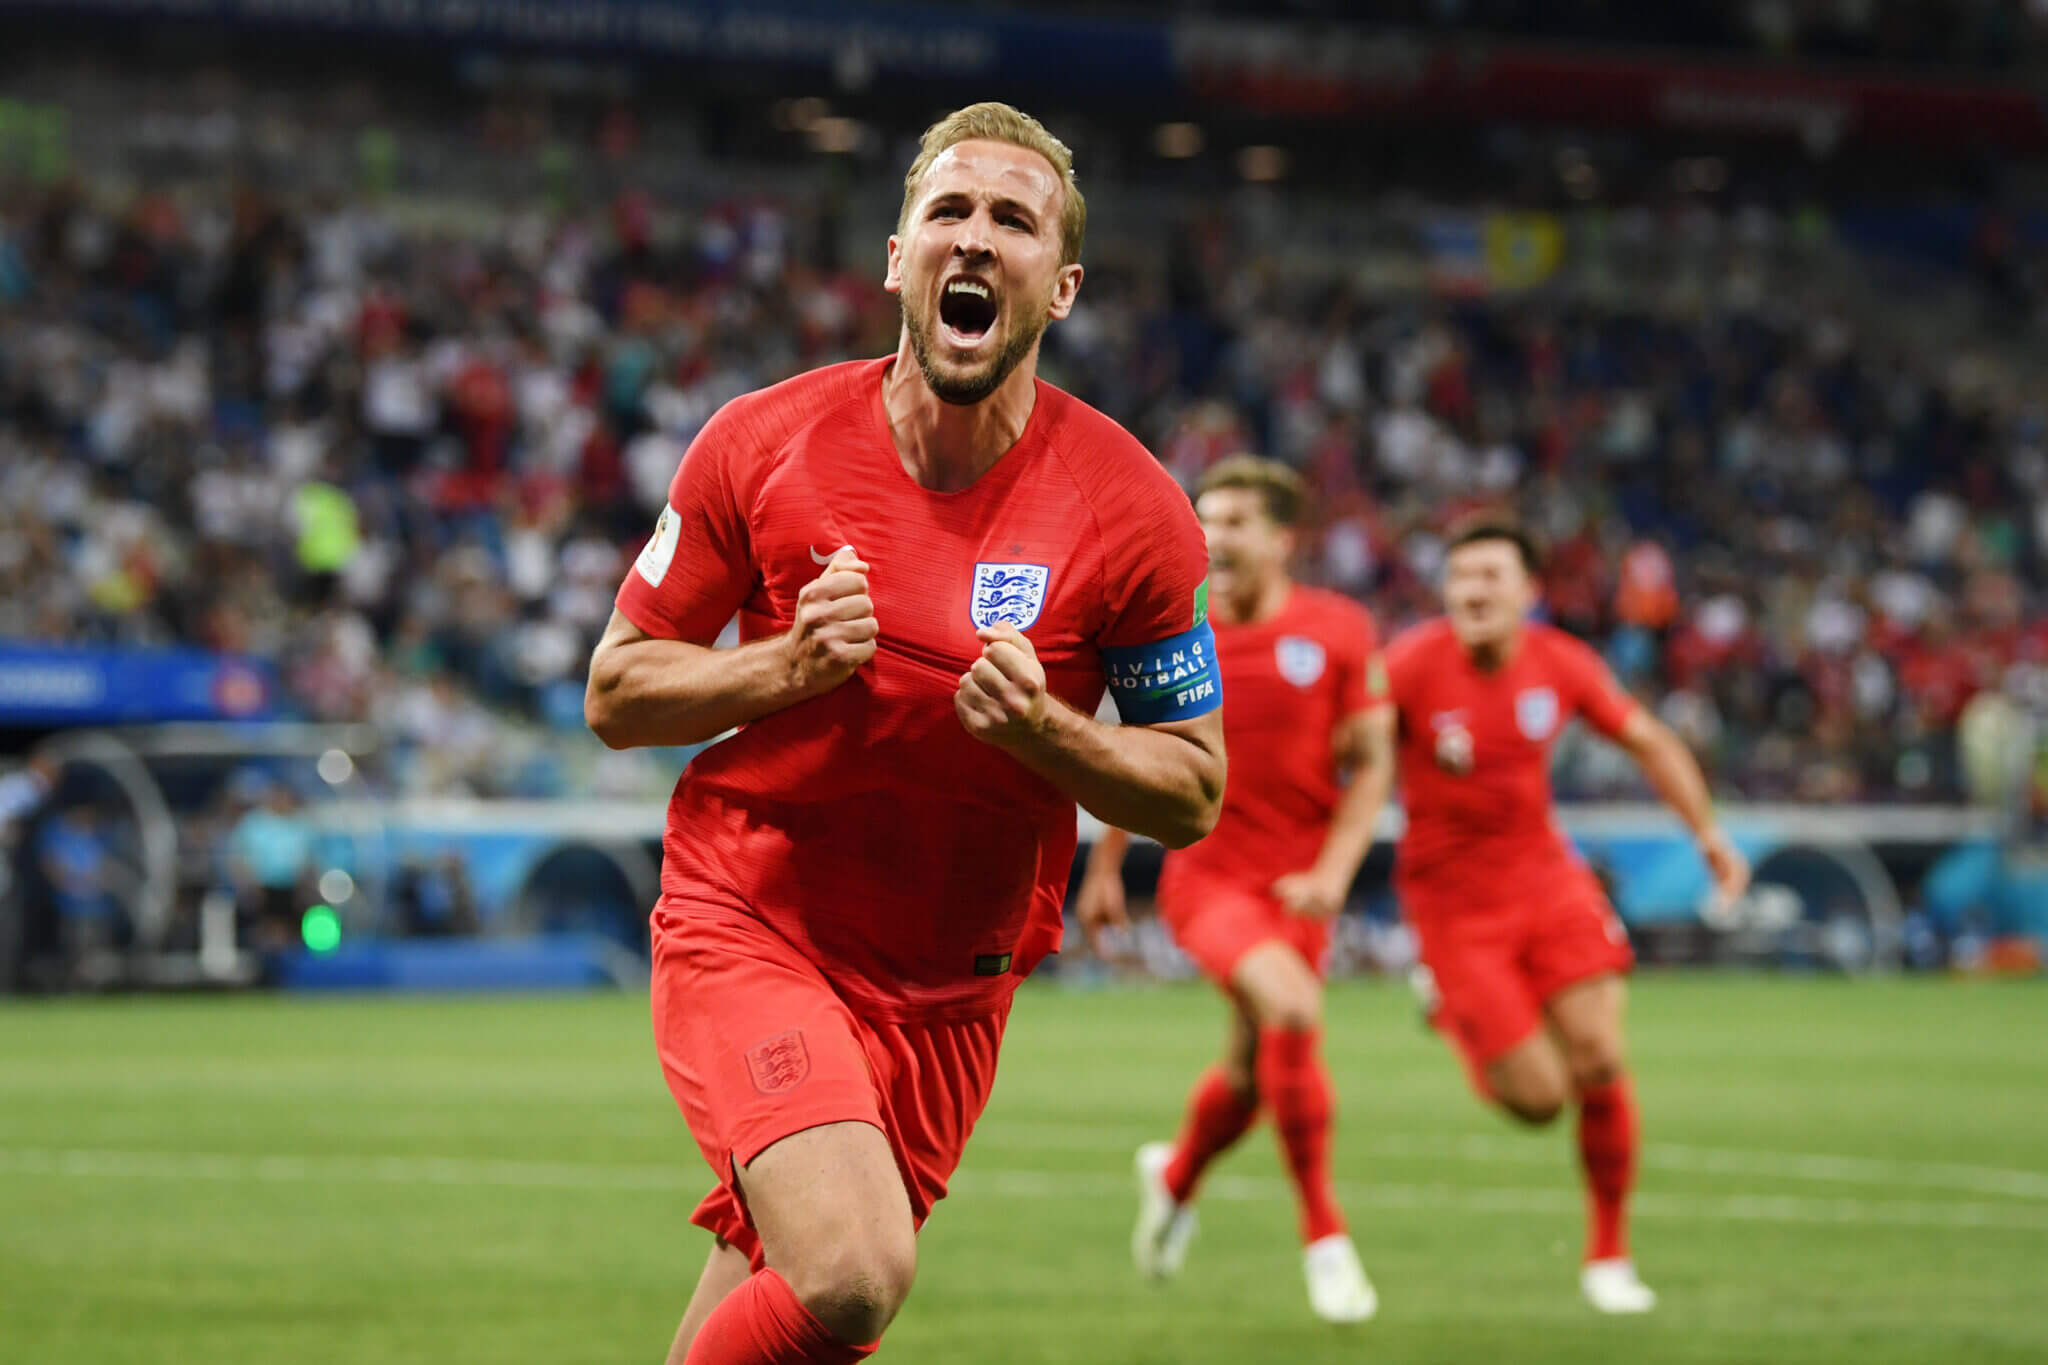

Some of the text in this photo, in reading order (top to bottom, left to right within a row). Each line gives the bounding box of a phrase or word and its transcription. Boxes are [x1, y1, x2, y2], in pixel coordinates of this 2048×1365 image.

[1111, 657, 1207, 688] OOTBALL
[1112, 642, 1202, 674] IVING
[1177, 681, 1214, 706] FIFA
